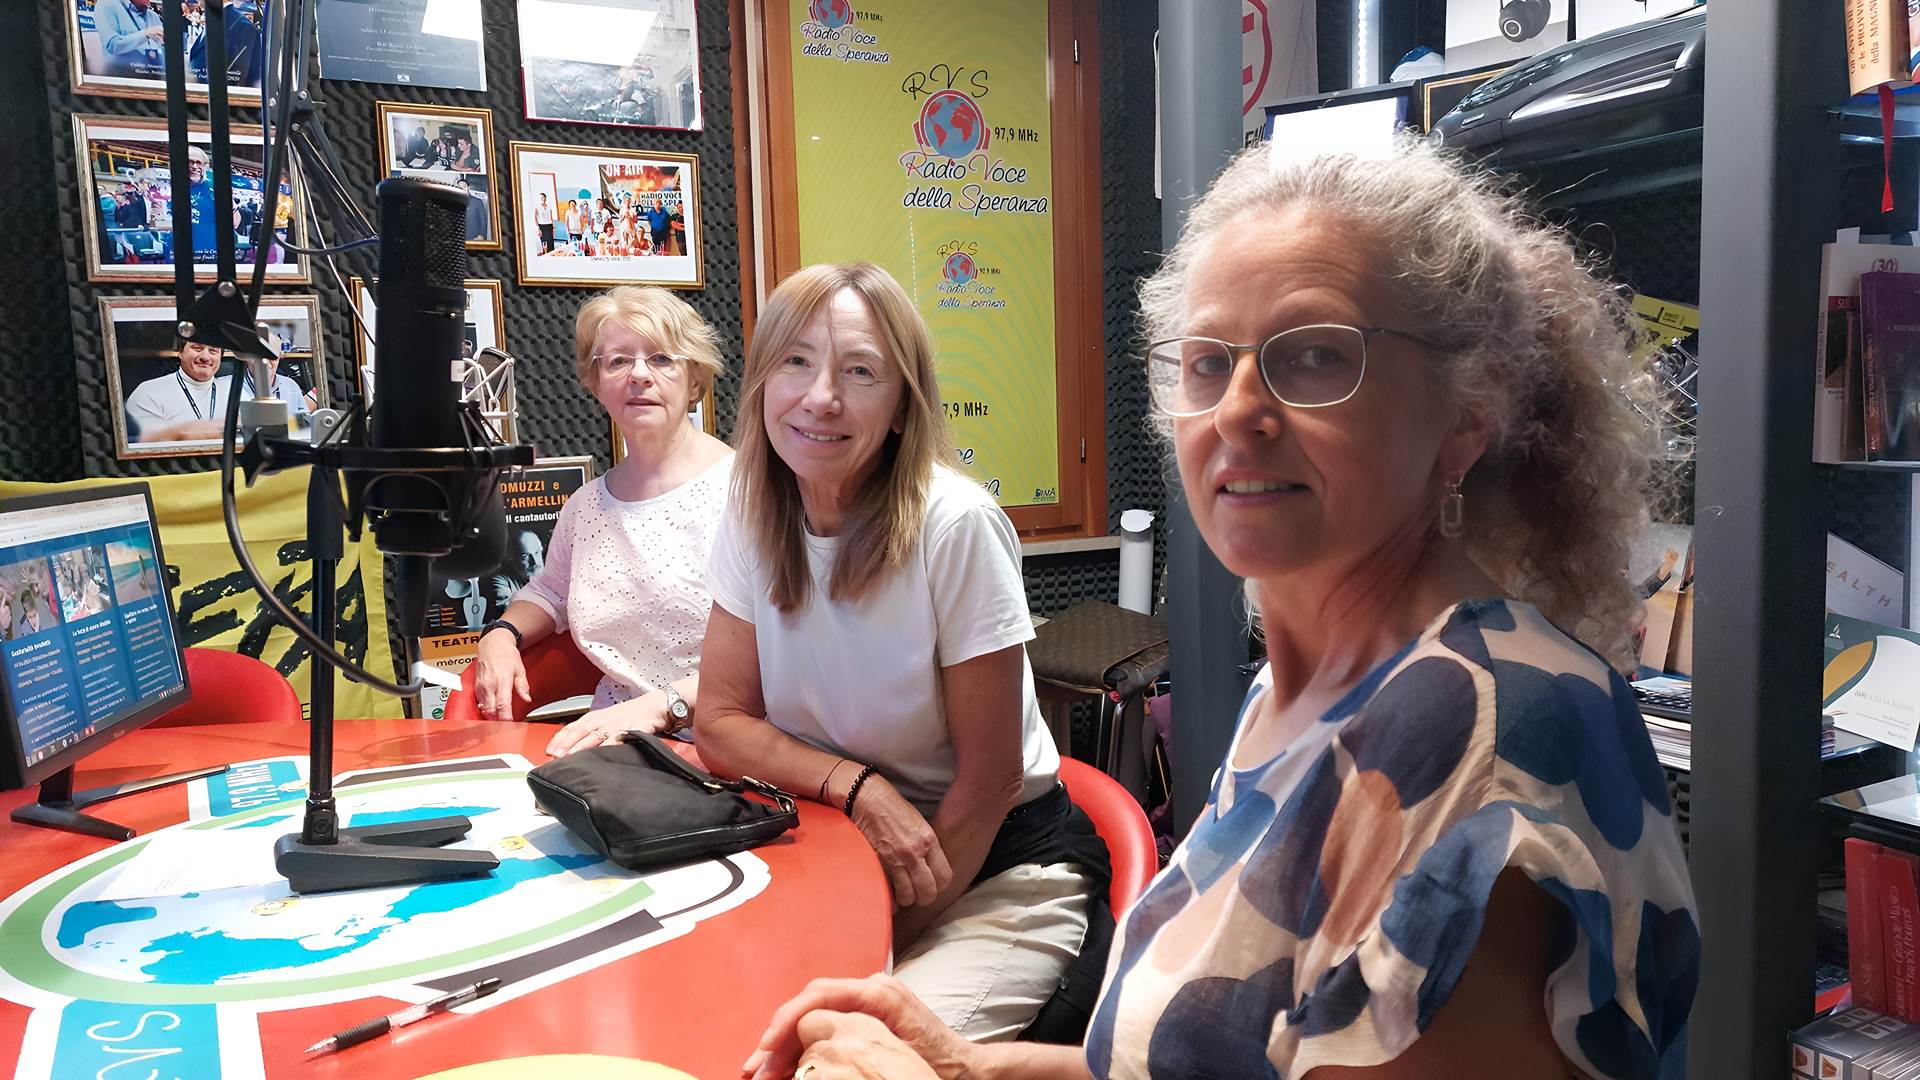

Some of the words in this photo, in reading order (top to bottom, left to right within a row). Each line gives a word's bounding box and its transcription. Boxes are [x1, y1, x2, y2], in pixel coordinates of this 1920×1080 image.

[800, 22, 840, 41] Radio
[841, 26, 877, 45] Voce
[803, 43, 832, 57] della
[835, 43, 890, 62] Speranza
[994, 127, 1015, 143] 97,9
[1018, 128, 1038, 143] MHz
[899, 151, 967, 180] Radio
[968, 154, 1026, 183] Voce
[903, 187, 952, 209] della
[958, 184, 1048, 216] Speranza
[937, 297, 960, 308] della
[942, 403, 960, 421] 7,9
[964, 402, 988, 417] MHz
[499, 481, 545, 494] OMUZZI
[552, 481, 560, 490] e
[1826, 559, 1892, 608] EALTH
[432, 636, 480, 649] TEATR
